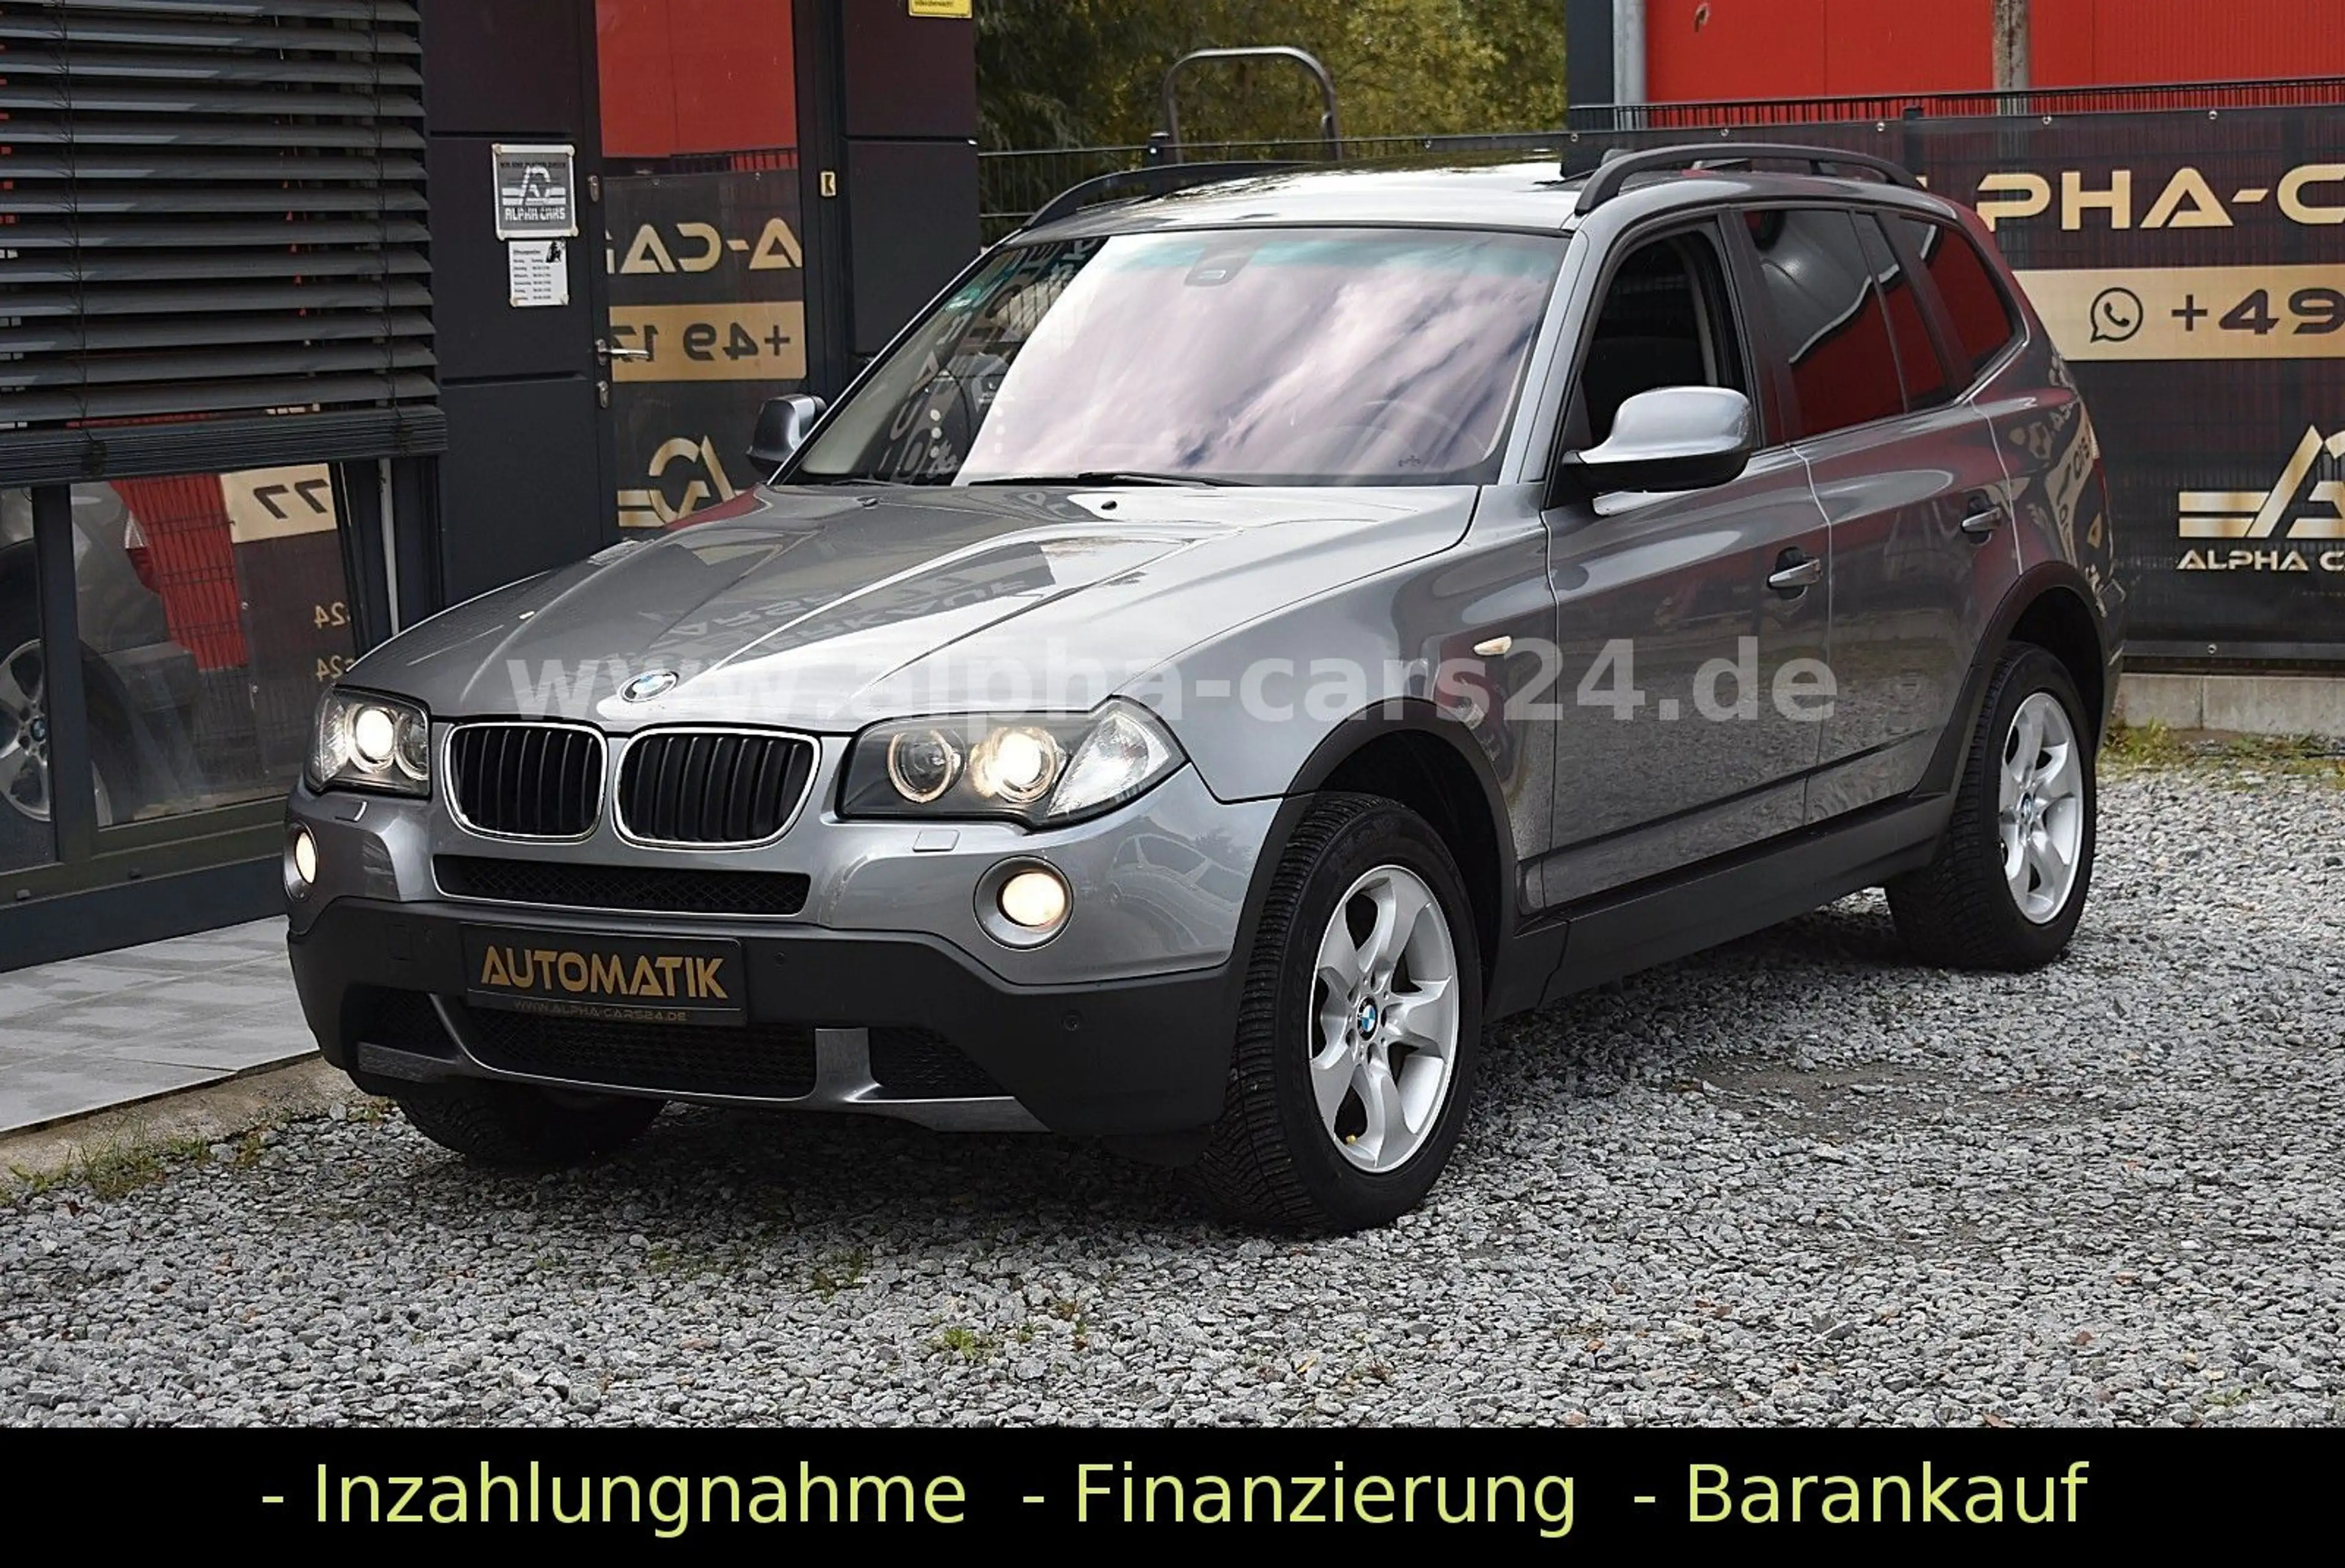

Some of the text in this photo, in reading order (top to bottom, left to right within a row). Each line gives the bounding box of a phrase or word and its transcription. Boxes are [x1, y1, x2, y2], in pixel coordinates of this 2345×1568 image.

[1916, 163, 2345, 231] PHA-C
[2171, 288, 2345, 335] +49
[2176, 549, 2309, 572] ALPHA
[481, 945, 729, 1000] AUTOMATIK
